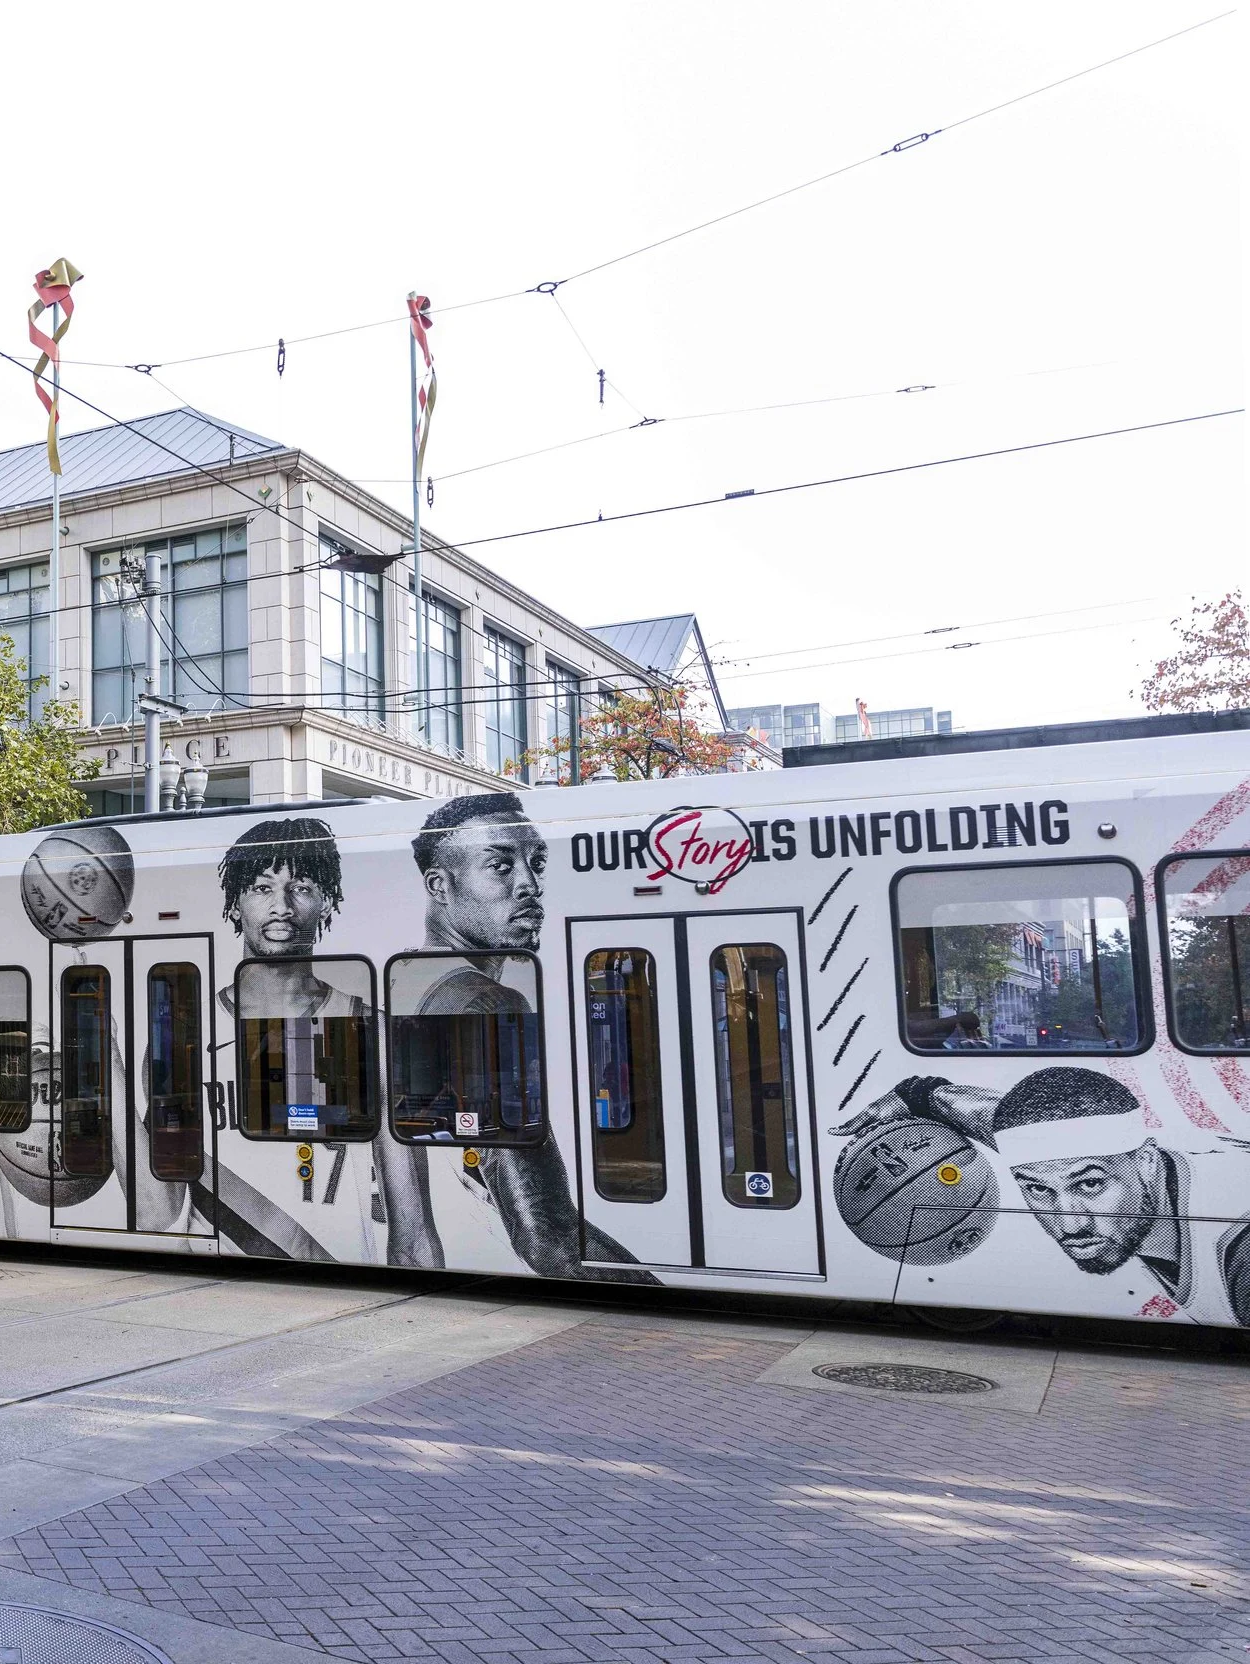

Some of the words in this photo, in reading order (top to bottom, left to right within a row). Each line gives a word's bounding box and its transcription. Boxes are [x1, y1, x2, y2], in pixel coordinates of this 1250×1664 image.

[329, 739, 411, 785] PIONEER
[571, 829, 647, 872] OUR
[647, 811, 760, 895] Story
[750, 819, 797, 863] IS
[809, 800, 1070, 858] UNFOLDING
